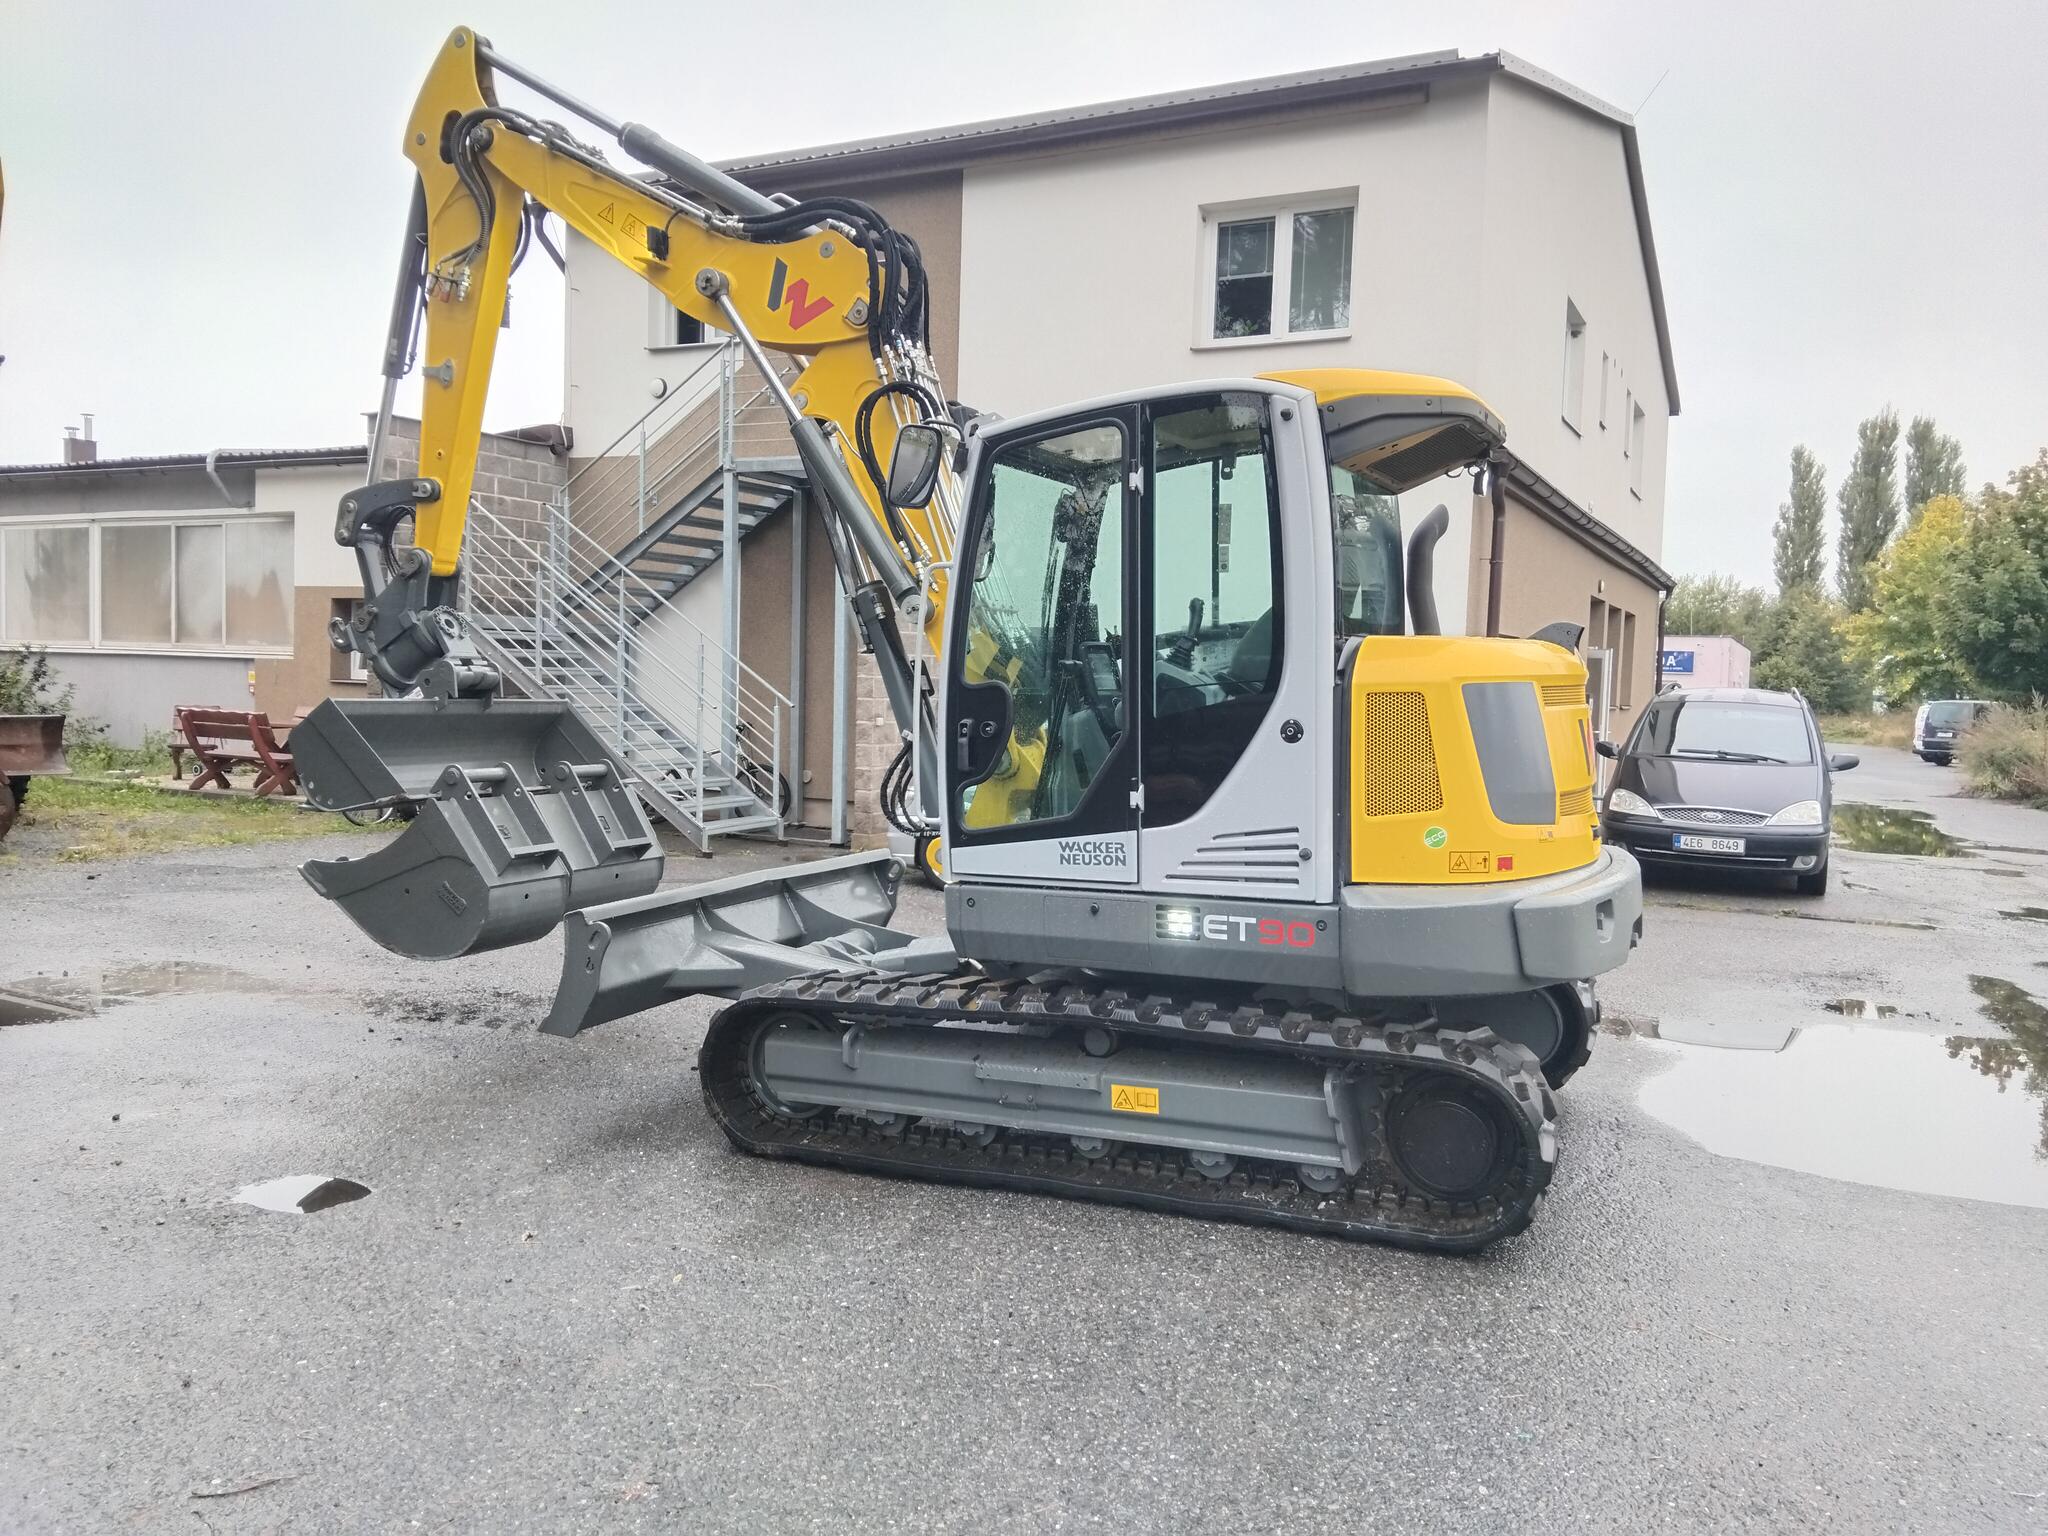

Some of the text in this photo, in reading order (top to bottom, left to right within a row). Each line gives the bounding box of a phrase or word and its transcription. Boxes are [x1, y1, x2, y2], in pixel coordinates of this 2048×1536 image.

[1058, 841, 1126, 854] WACKER
[1683, 837, 1739, 850] 4E6 8649
[1059, 854, 1127, 866] NEUSON
[1203, 914, 1316, 948] ET90
